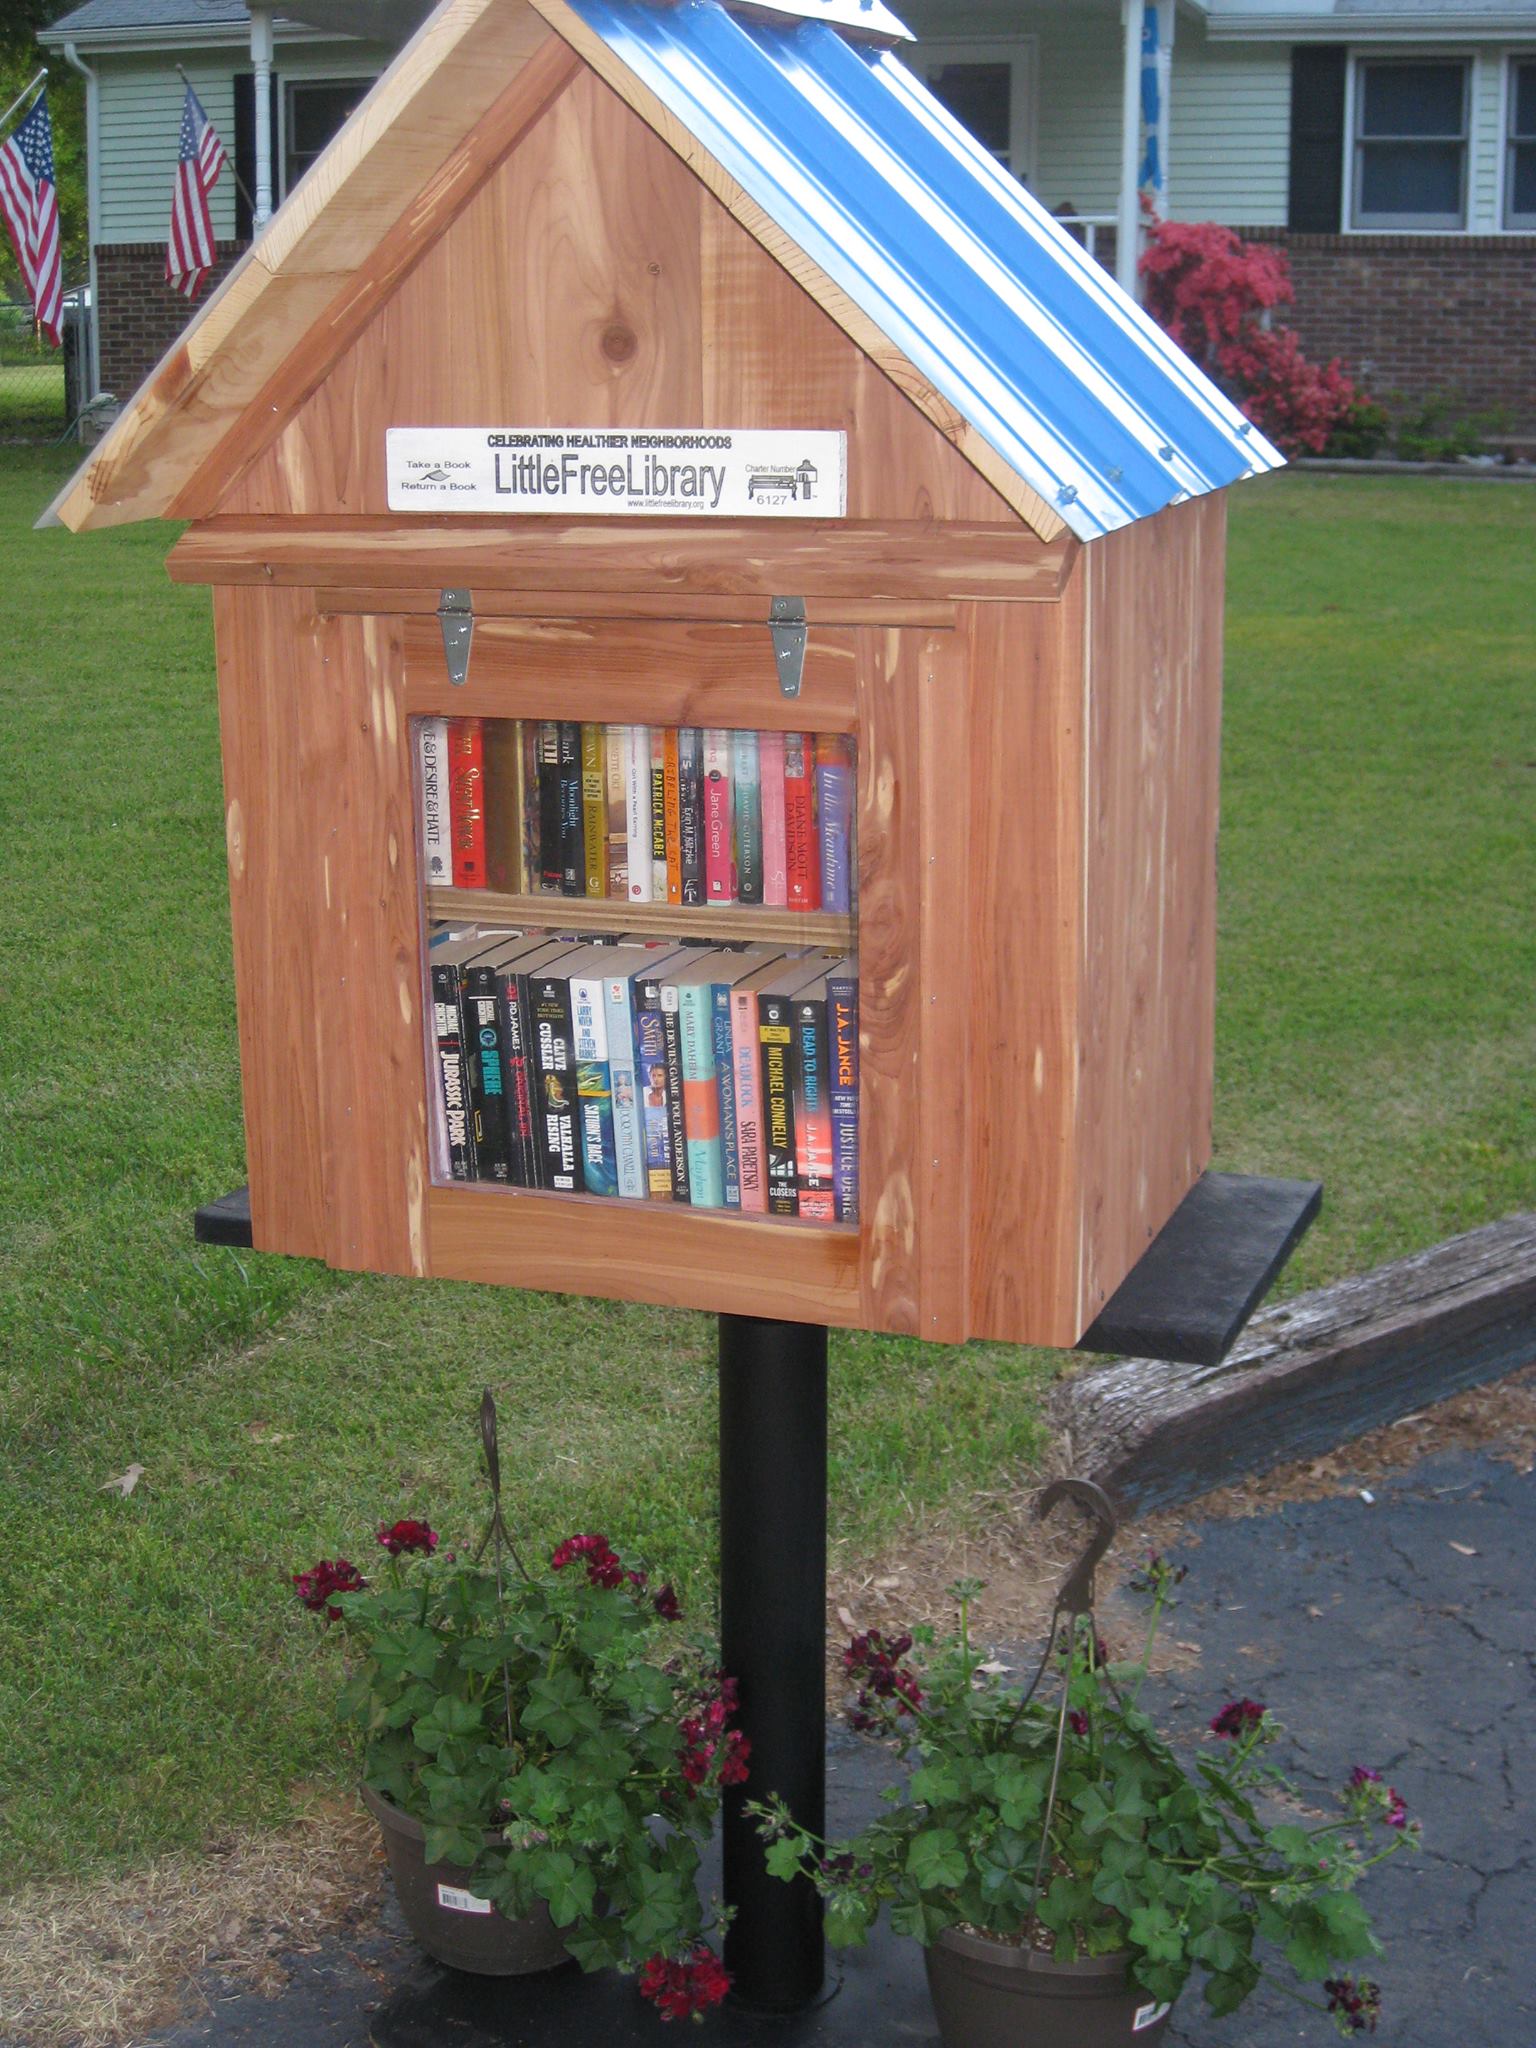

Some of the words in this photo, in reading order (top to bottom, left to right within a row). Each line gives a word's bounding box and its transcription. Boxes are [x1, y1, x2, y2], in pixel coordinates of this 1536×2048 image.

[487, 434, 564, 448] CELEBRATING
[566, 434, 629, 448] HEALTHIER
[631, 435, 732, 449] NEIGHBORHOODS
[406, 461, 431, 469] Take
[444, 460, 471, 469] Book
[494, 453, 726, 508] LittleFreeLibrary
[745, 464, 769, 474] Charter
[770, 464, 795, 474] Number
[401, 482, 437, 491] Return
[450, 482, 477, 491] Book
[627, 499, 705, 511] www.littlefreelibrary.org
[756, 495, 787, 505] 6127
[424, 755, 438, 798] DESIRE
[652, 773, 664, 814] PATRICK
[567, 780, 581, 828] Moonlight
[710, 788, 722, 818] Jane
[427, 814, 440, 846] HATE
[711, 819, 723, 858] Green
[743, 825, 752, 875] GUTERSON
[445, 1005, 460, 1034] MICHAEL
[641, 1016, 660, 1056] SMITH
[665, 1012, 675, 1029] HE
[686, 1010, 697, 1038] MARY
[713, 1016, 725, 1056] GRANT
[723, 1019, 732, 1053] LINDA
[539, 1022, 554, 1071] CUSSLER
[553, 1037, 567, 1071] CLIVE
[687, 1040, 699, 1080] DAHEIM
[801, 1026, 816, 1057] DEAD
[838, 1035, 852, 1087] JANCE
[440, 1050, 462, 1109] JURASSIC
[481, 1050, 502, 1095] SPHERE
[668, 1067, 680, 1096] GAME
[720, 1062, 730, 1073] A
[768, 1046, 784, 1094] MICHAEL
[804, 1058, 817, 1073] TO
[445, 1109, 466, 1146] PARK
[546, 1114, 560, 1153] RISING
[583, 1104, 601, 1143] SATURN'S
[671, 1101, 682, 1127] POUL
[740, 1121, 756, 1144] SARA
[770, 1096, 787, 1150] CONNELLY
[559, 1115, 575, 1171] VALHALLA
[587, 1143, 604, 1164] RACE
[673, 1129, 685, 1182] ANDERSON
[724, 1141, 737, 1180] PLACE
[839, 1123, 855, 1171] JUSTICE
[743, 1145, 759, 1192] PARETSKY
[769, 1187, 797, 1198] CLOSERS
[841, 1176, 856, 1217] DENIE
